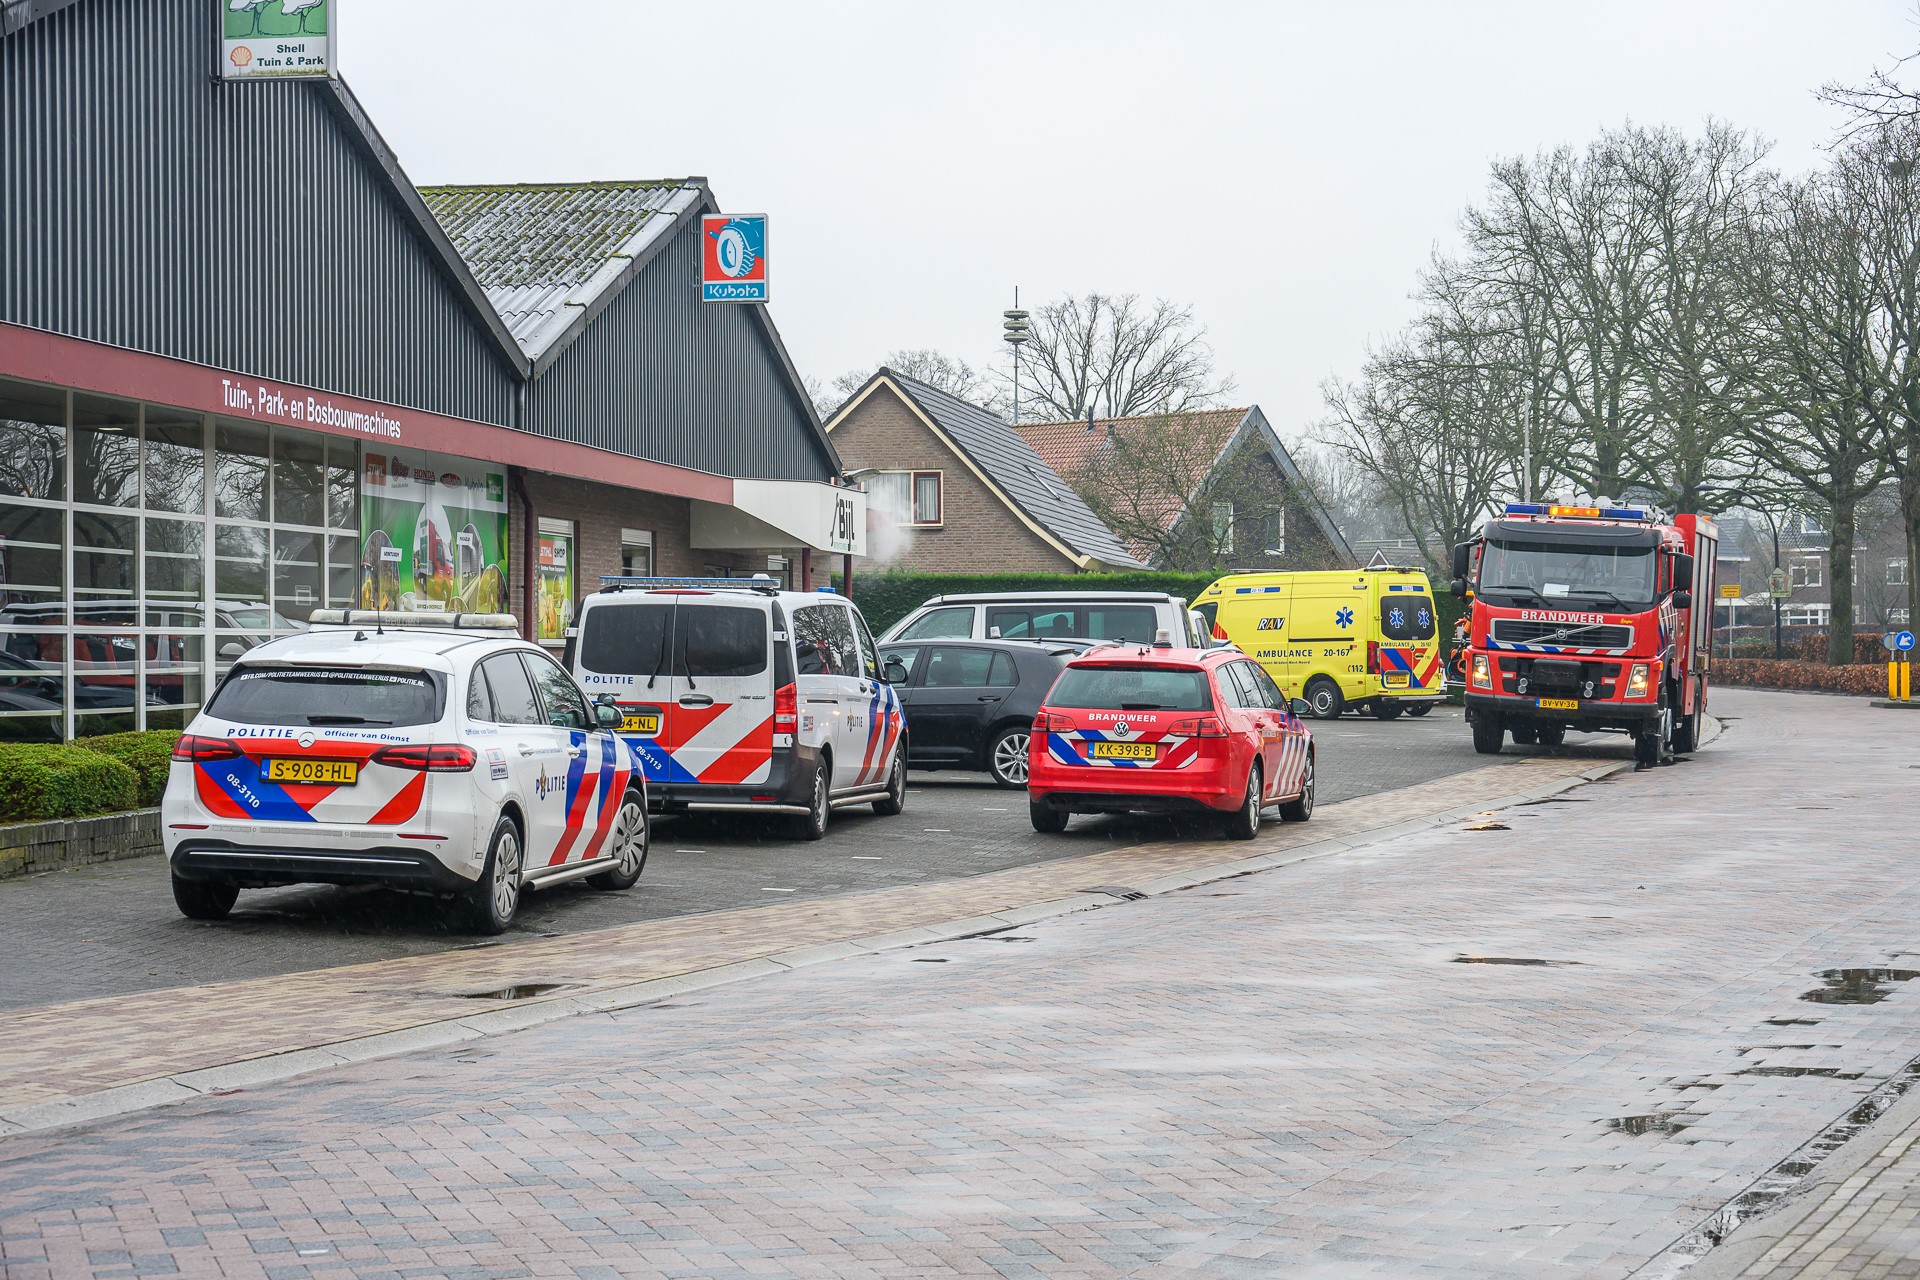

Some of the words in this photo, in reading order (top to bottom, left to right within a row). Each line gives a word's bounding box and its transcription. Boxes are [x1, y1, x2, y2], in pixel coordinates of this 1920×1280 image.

[276, 44, 305, 53] Shell
[257, 57, 281, 67] Tuin
[286, 57, 294, 66] &
[298, 56, 324, 66] Park
[709, 284, 759, 297] Kubota
[258, 386, 289, 417] Park-
[290, 401, 304, 421] en
[307, 396, 401, 439] Bosbouwmachines
[413, 468, 436, 480] HONDA
[554, 547, 566, 558] SHOP
[1521, 610, 1604, 624] BRANDWEER
[1258, 618, 1285, 630] RAV
[1256, 649, 1312, 658] AMBULANCE
[396, 677, 425, 687] POLITIE.NL
[585, 675, 634, 684] POLITIE
[1542, 699, 1576, 708] BV-VV-36
[1088, 713, 1157, 723] BRANDWEER
[227, 728, 294, 738] POLITIE
[324, 730, 358, 738] Officier
[380, 733, 410, 743] Dienst
[1098, 744, 1152, 756] KK-398-B
[635, 745, 662, 770] 08-3113
[274, 762, 352, 780] S-908-HL
[226, 773, 261, 808] 08-3110
